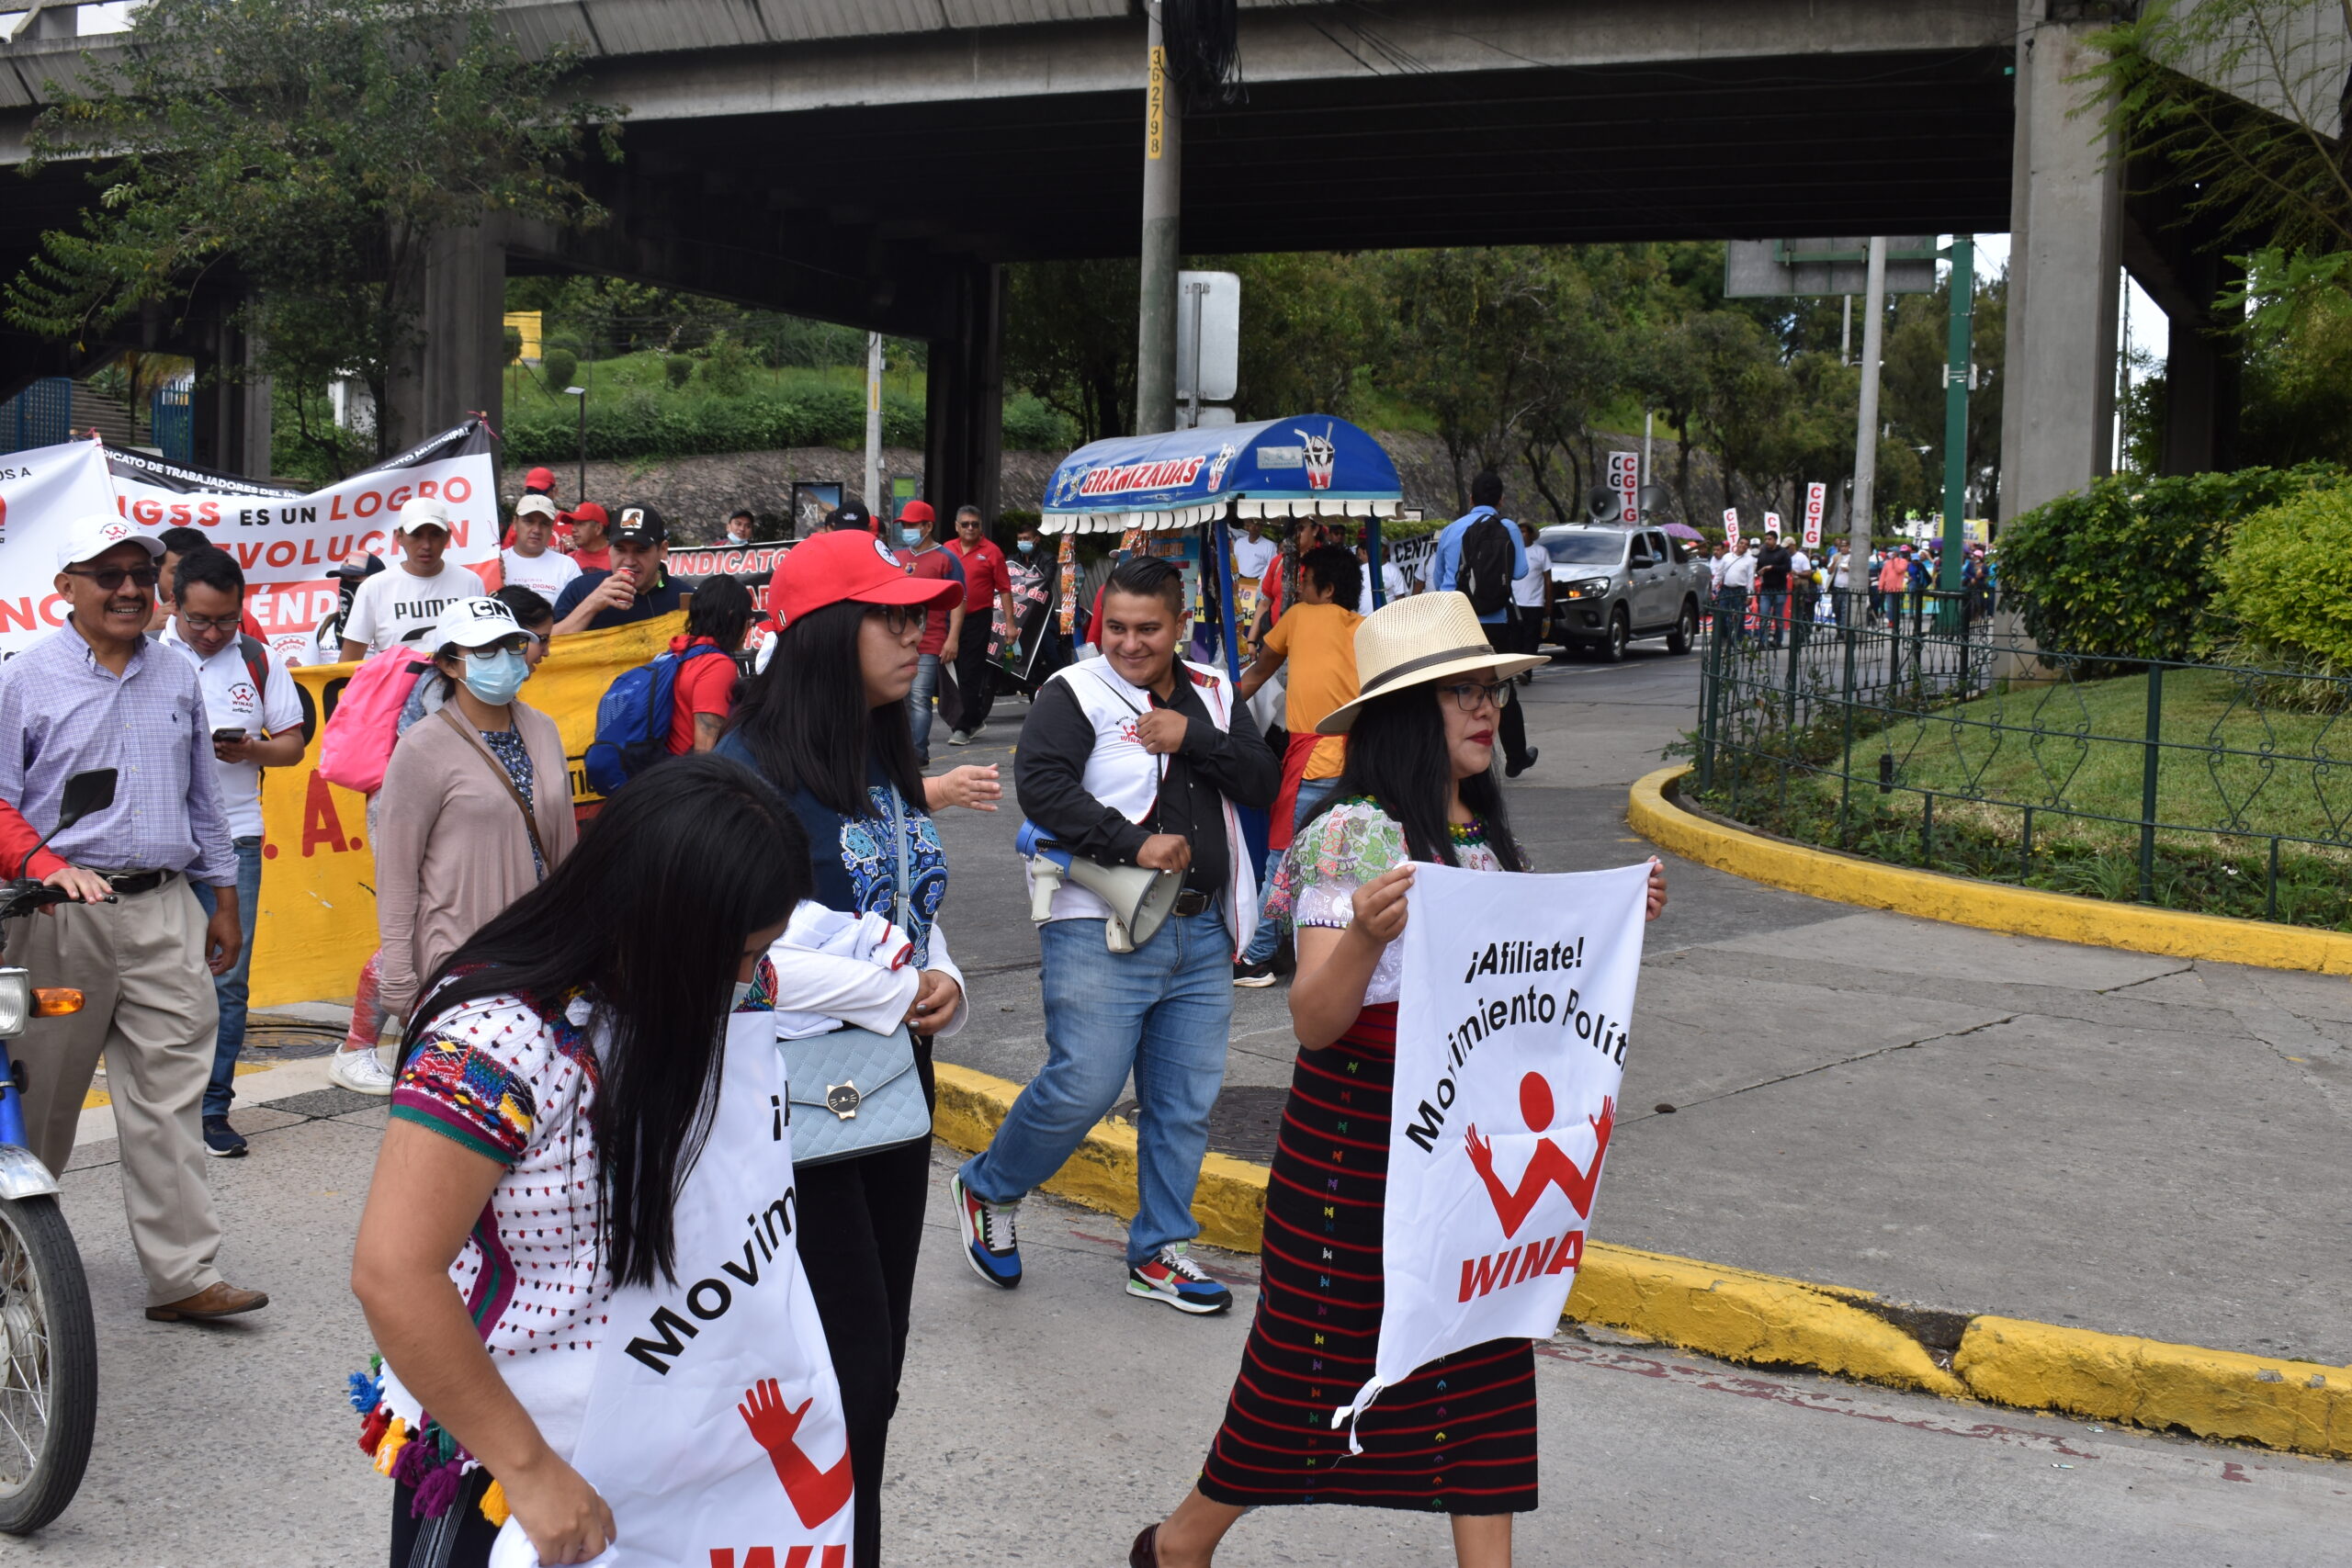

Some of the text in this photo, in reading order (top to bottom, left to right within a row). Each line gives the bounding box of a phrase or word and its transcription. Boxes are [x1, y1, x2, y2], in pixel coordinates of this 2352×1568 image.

[1150, 49, 1161, 153] 362798
[414, 426, 471, 457] MUNICIPAL
[21, 467, 31, 478] A
[147, 461, 164, 473] DE
[165, 465, 258, 494] TRABAJADORES
[258, 488, 281, 497] DEL
[1080, 457, 1204, 495] GRANIZADAS
[1623, 457, 1638, 523] CGTG
[240, 508, 270, 526] ES
[281, 506, 316, 525] UN
[330, 476, 472, 521] LOGRO
[1805, 486, 1823, 544] CGTG
[469, 601, 511, 617] CN
[1120, 736, 1142, 745] WINA
[1464, 936, 1585, 984] ¡Afíliate!
